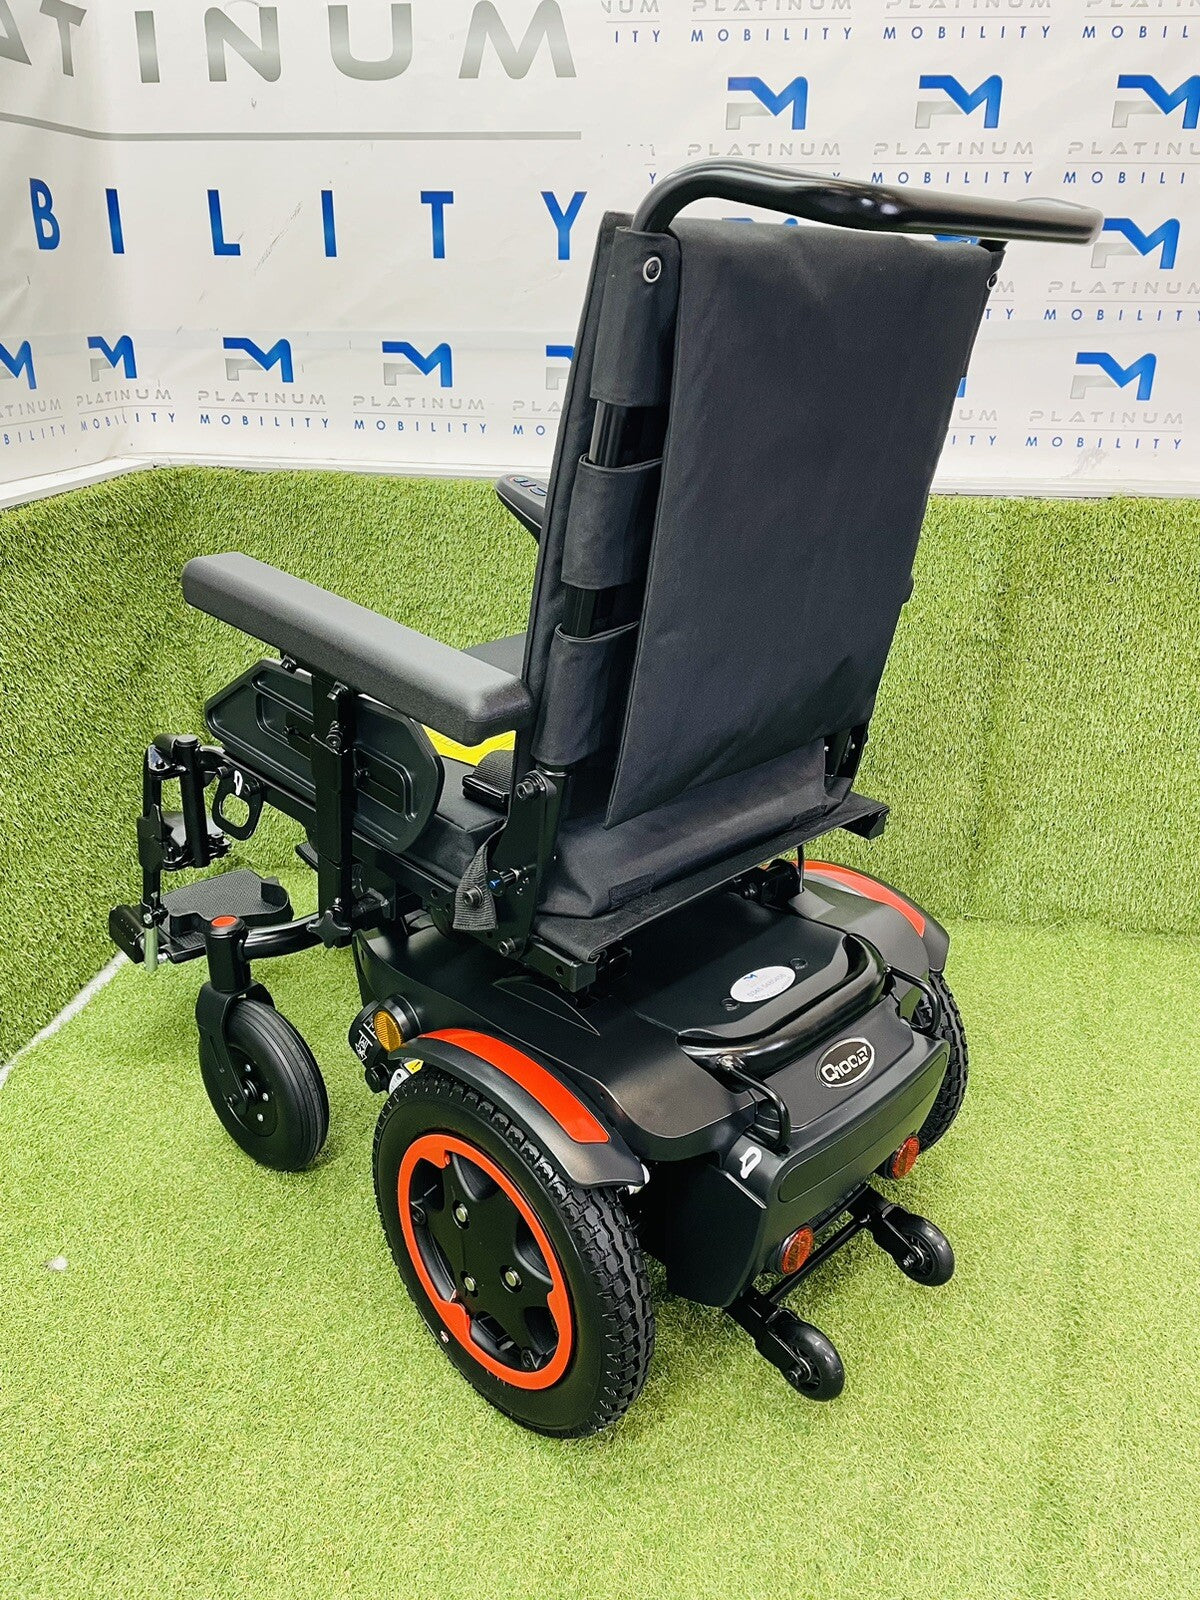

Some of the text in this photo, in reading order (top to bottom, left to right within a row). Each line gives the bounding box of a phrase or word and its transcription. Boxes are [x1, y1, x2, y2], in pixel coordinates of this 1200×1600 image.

[690, 27, 852, 42] MOBILITY
[883, 25, 1050, 39] MOBILITY
[1082, 25, 1188, 39] MOBIL
[687, 143, 841, 156] PLATINUM
[873, 141, 1034, 156] PLATINUM
[870, 171, 1033, 185] MOBILITY
[1063, 171, 1185, 184] MOBILI
[29, 178, 588, 260] BILITY
[1044, 308, 1200, 321] MOBILIT
[76, 389, 172, 407] PLATINUM
[197, 391, 327, 405] PLATINUM
[352, 395, 485, 411] PLATINUM
[80, 412, 176, 432] MOBILITY
[200, 413, 330, 428] MOBILITY
[1029, 410, 1184, 425] PLATINUM
[353, 419, 488, 435] MOBILITY
[1025, 436, 1183, 450] MOBILITY
